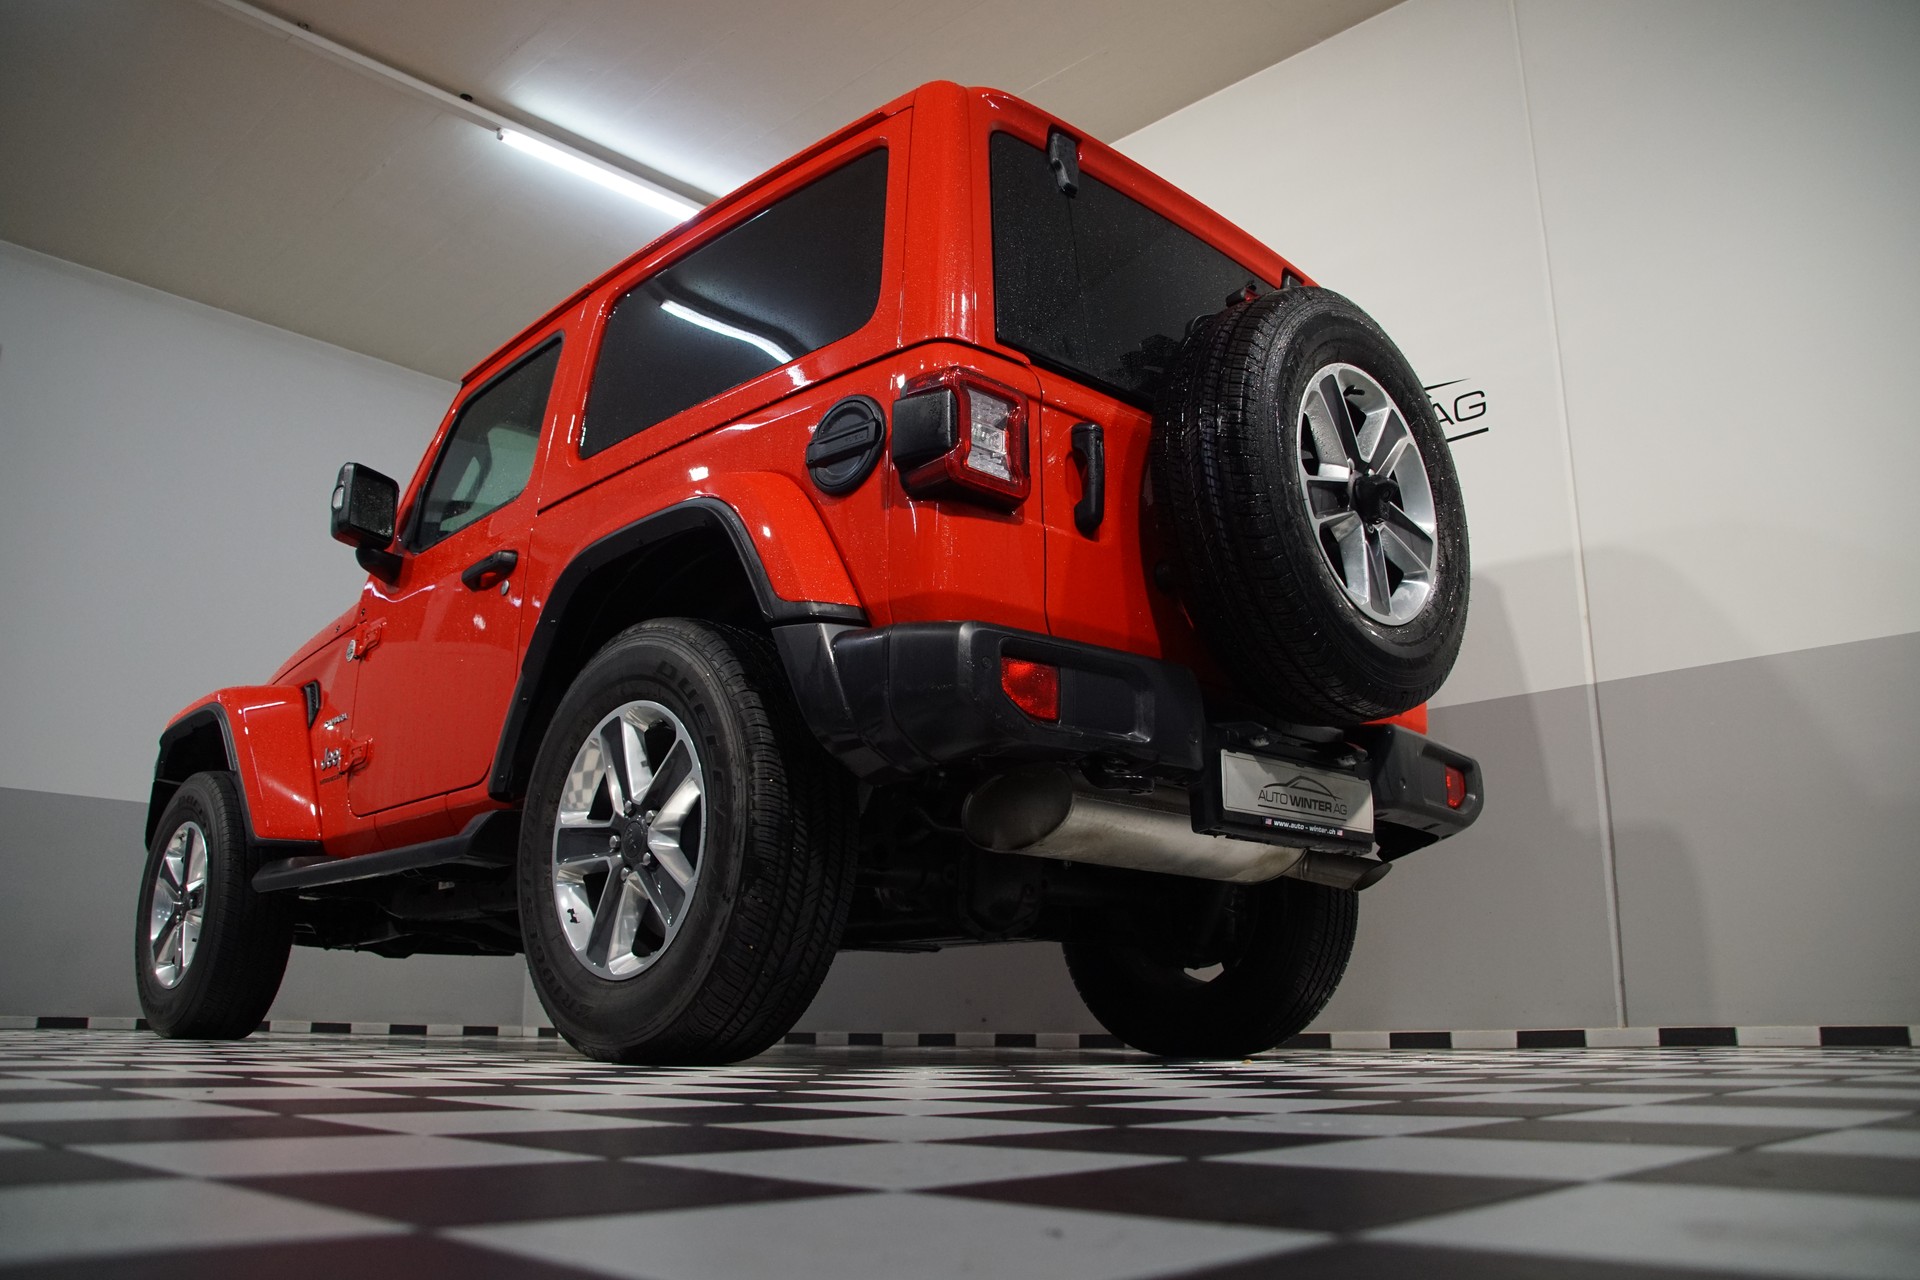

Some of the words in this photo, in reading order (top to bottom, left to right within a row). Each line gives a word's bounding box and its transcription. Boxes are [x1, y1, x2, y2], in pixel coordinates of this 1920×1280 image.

[1432, 390, 1487, 425] AG
[1258, 790, 1288, 805] AUTO
[1290, 795, 1332, 813] WINTER
[1333, 804, 1348, 816] AG
